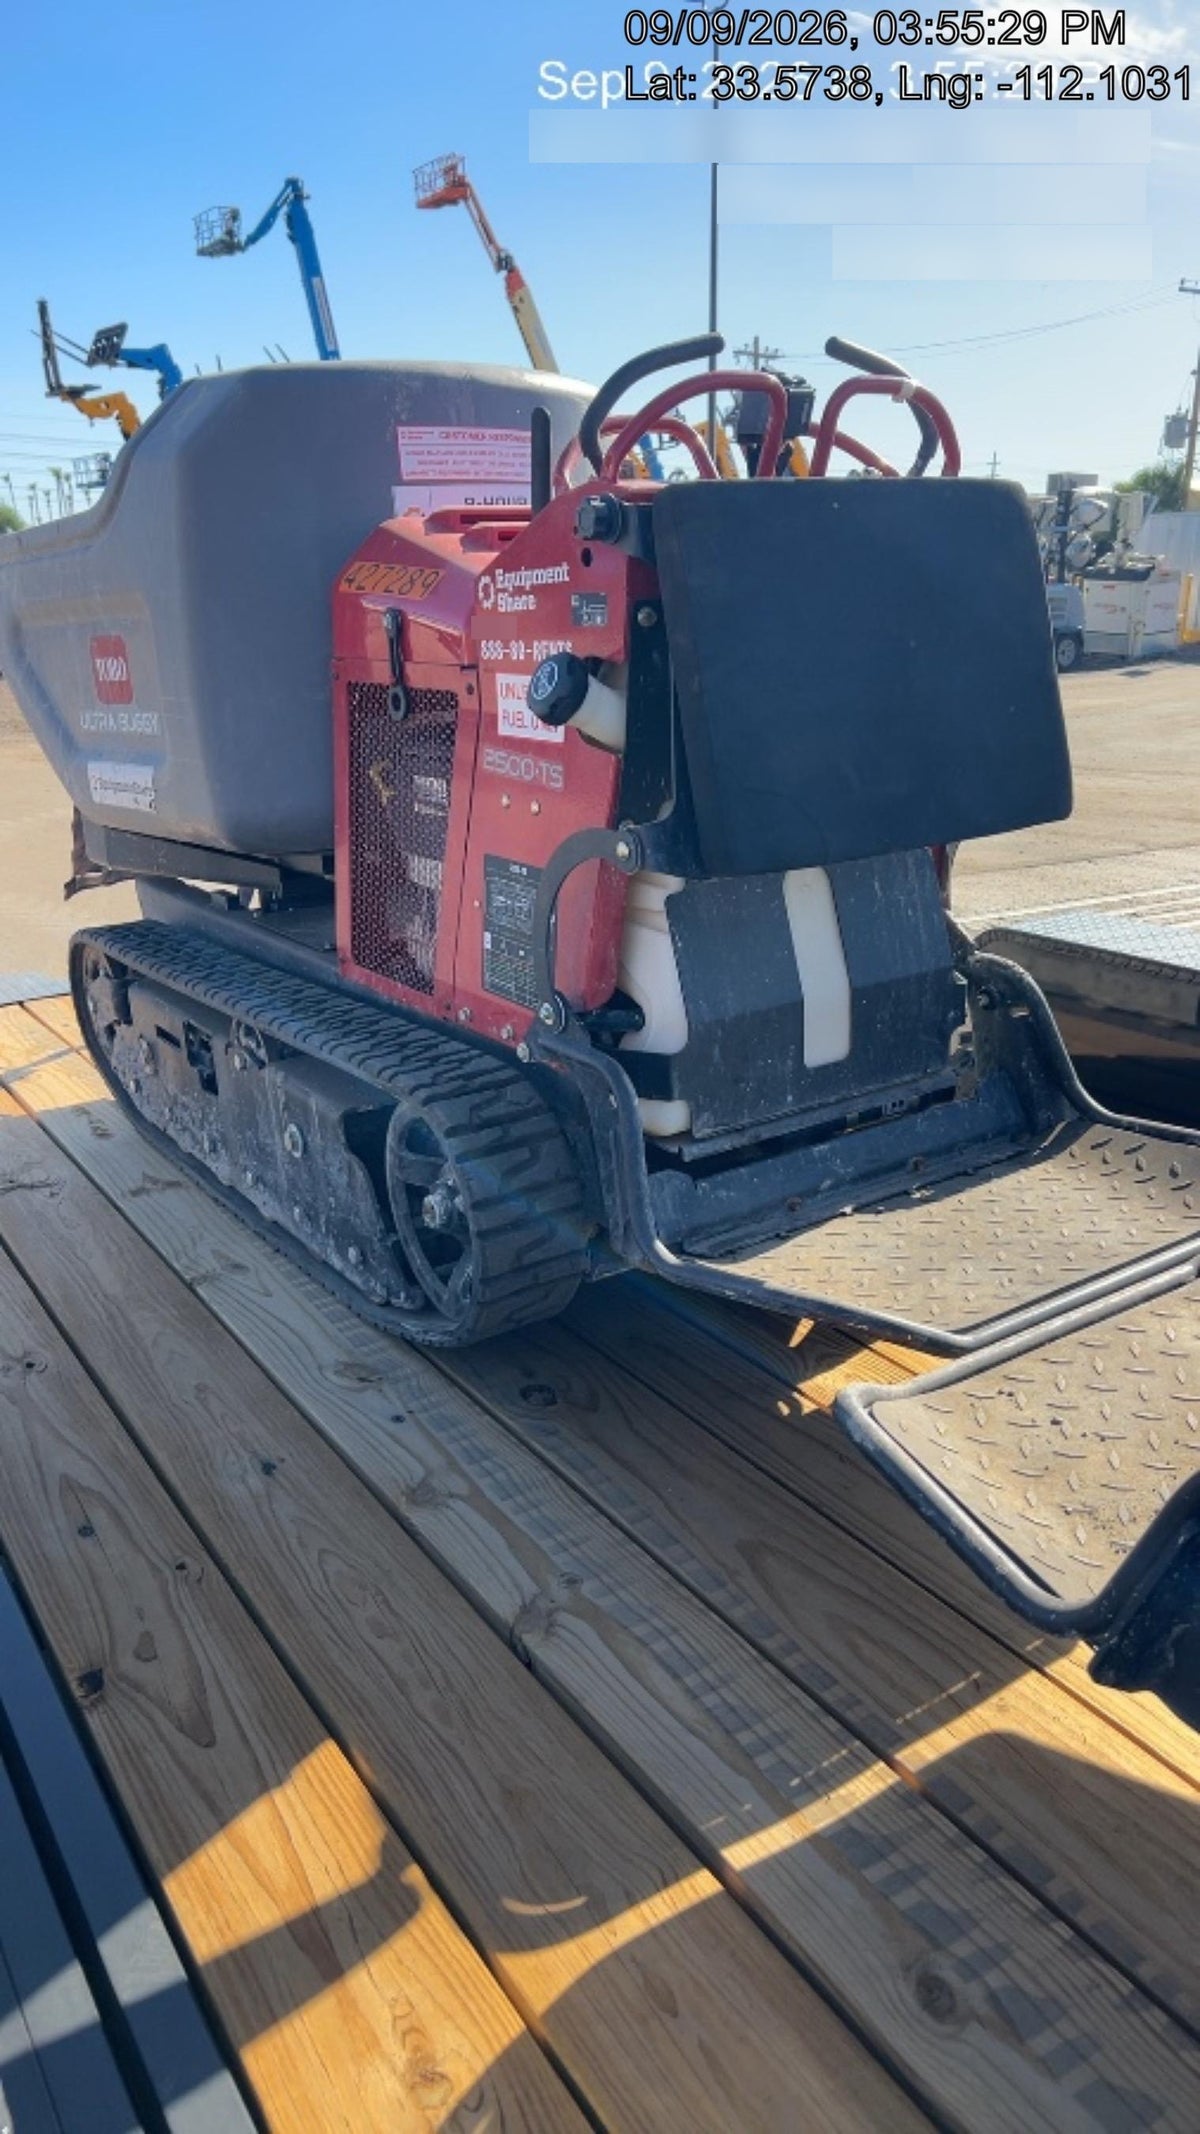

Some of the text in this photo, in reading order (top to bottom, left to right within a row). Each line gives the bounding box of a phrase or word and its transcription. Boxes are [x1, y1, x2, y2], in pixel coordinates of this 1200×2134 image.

[343, 563, 440, 598] 427289
[495, 562, 570, 592] Equipment
[497, 592, 537, 612] Share
[502, 709, 529, 728] FUEL
